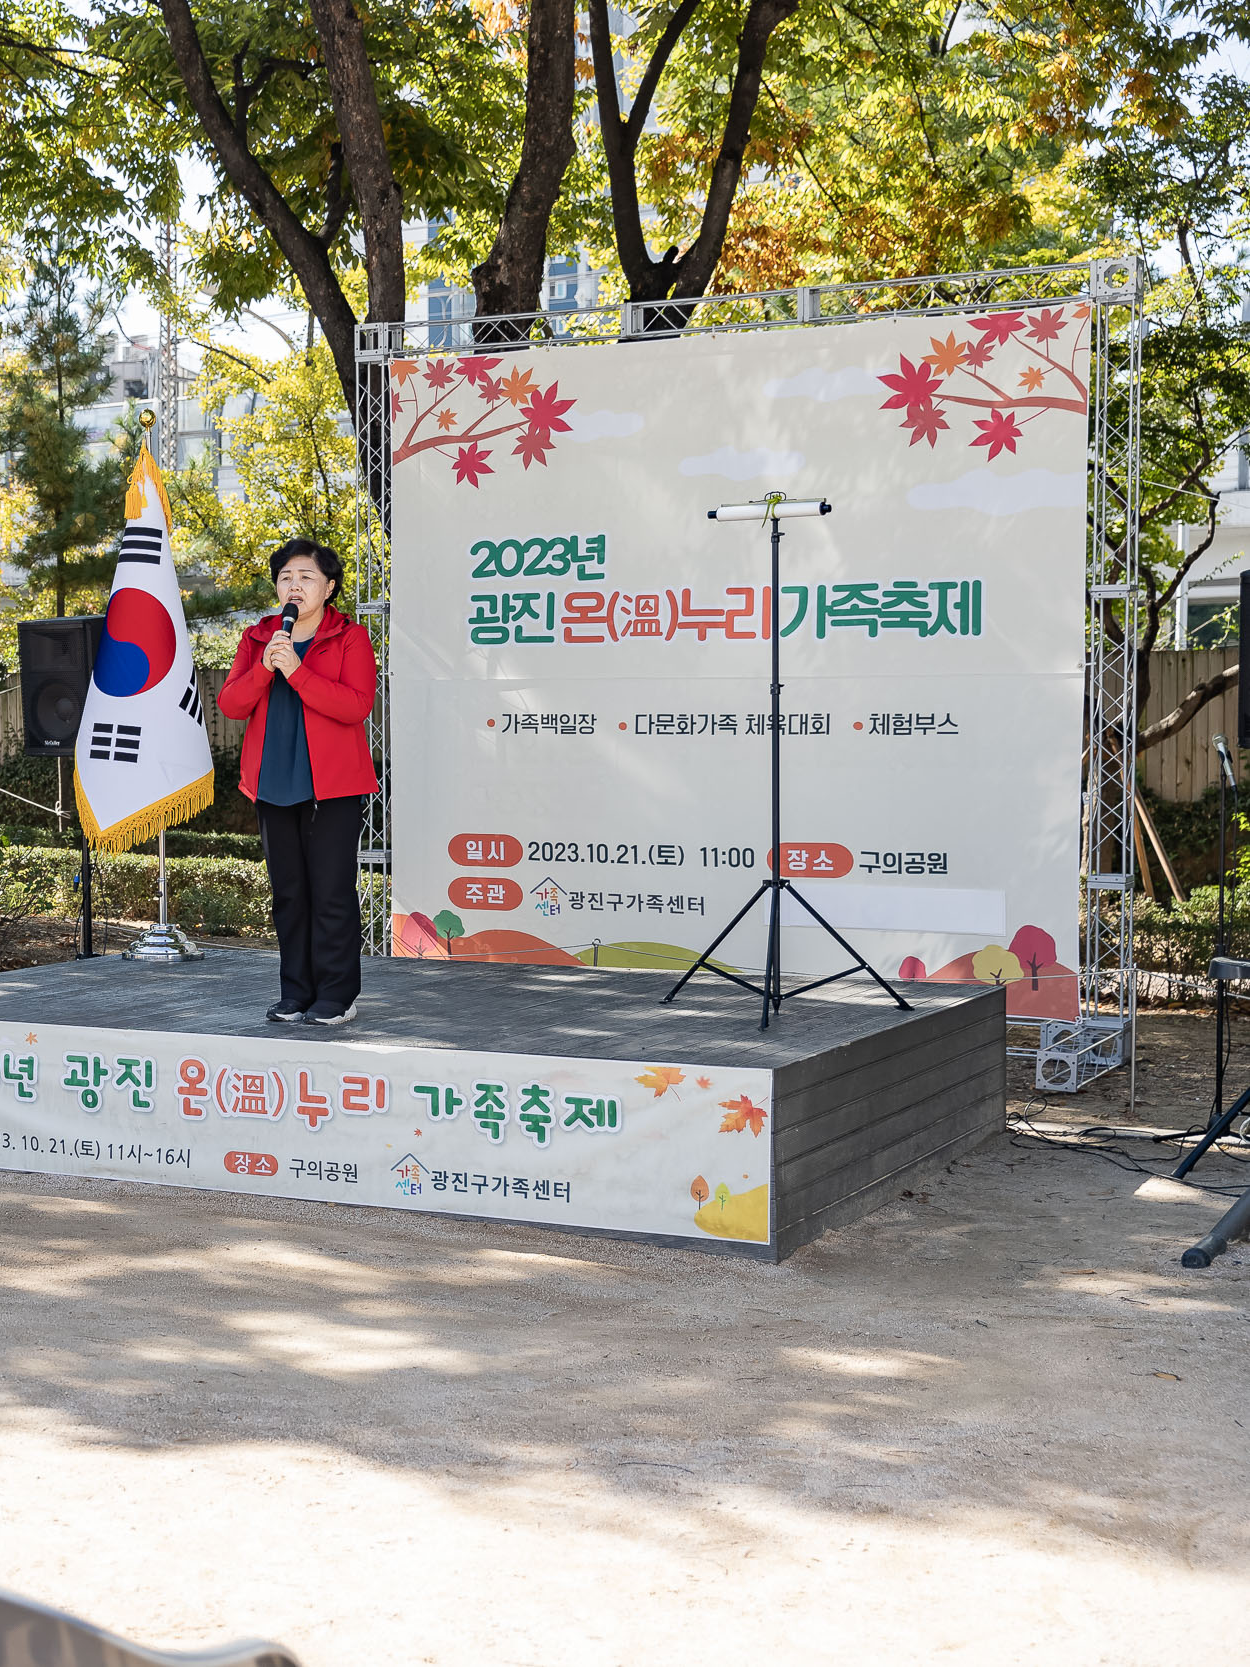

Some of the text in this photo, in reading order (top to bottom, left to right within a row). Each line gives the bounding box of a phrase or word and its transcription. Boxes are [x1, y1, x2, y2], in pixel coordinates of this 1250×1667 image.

[469, 534, 606, 581] 2023년
[468, 591, 555, 645] 광진
[779, 579, 982, 639] 가족축제
[501, 713, 959, 736] 가족백일장 다문화가족 체육대회 체험부스
[465, 840, 948, 875] 일시 2023.10.21.(토) 11:00 장소 구의공원
[465, 883, 705, 916] 주관 광진구가족센터
[63, 1054, 154, 1109] 광진
[177, 1058, 386, 1129] 온(溫)누리
[412, 1082, 619, 1144] 가족축제
[106, 1143, 192, 1169] 11시~16시
[288, 1157, 359, 1184] 구의공원
[430, 1169, 572, 1204] 광진구가족센터
